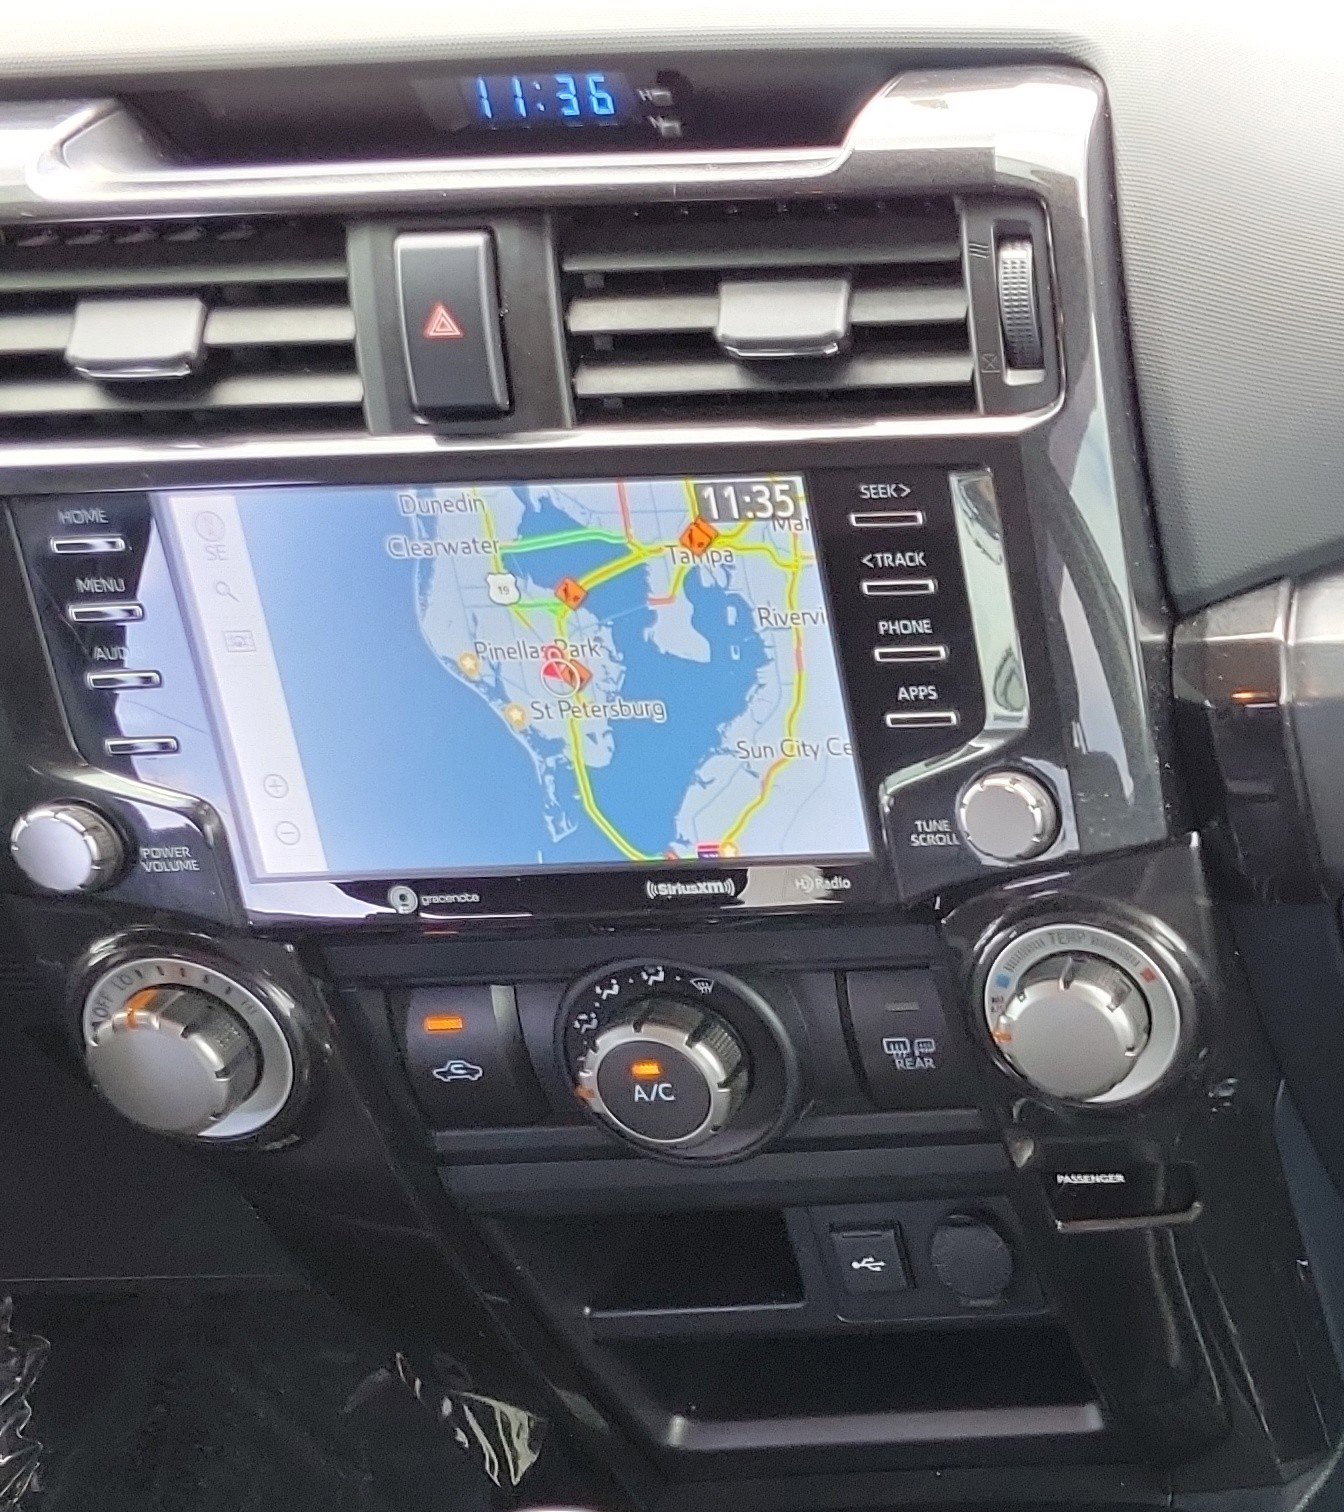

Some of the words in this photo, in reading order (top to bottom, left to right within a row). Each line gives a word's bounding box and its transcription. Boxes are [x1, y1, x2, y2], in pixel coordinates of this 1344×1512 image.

[477, 73, 615, 118] 11:36
[859, 484, 898, 499] SEEK
[401, 494, 485, 515] Dunedin
[703, 484, 795, 520] 11:35
[59, 508, 109, 525] HOME
[388, 537, 500, 557] Clearwater
[876, 551, 927, 567] TRACK
[75, 577, 126, 594] MENU
[498, 585, 510, 595] 19
[878, 618, 933, 635] PHONE
[92, 646, 134, 662] AUD
[554, 638, 601, 657] Park
[897, 685, 939, 700] APPS
[531, 701, 552, 720] St
[559, 699, 665, 723] Petersburg
[737, 740, 775, 758] Sun
[780, 738, 819, 758] City
[914, 820, 951, 833] TUNE
[910, 833, 960, 846] SCROLL
[140, 847, 192, 860] POWER
[140, 859, 200, 873] VOLUME
[815, 876, 851, 891] Radio
[895, 1057, 937, 1070] REAR
[633, 1083, 675, 1102] A/C
[1056, 1172, 1126, 1185] PASSENGER
